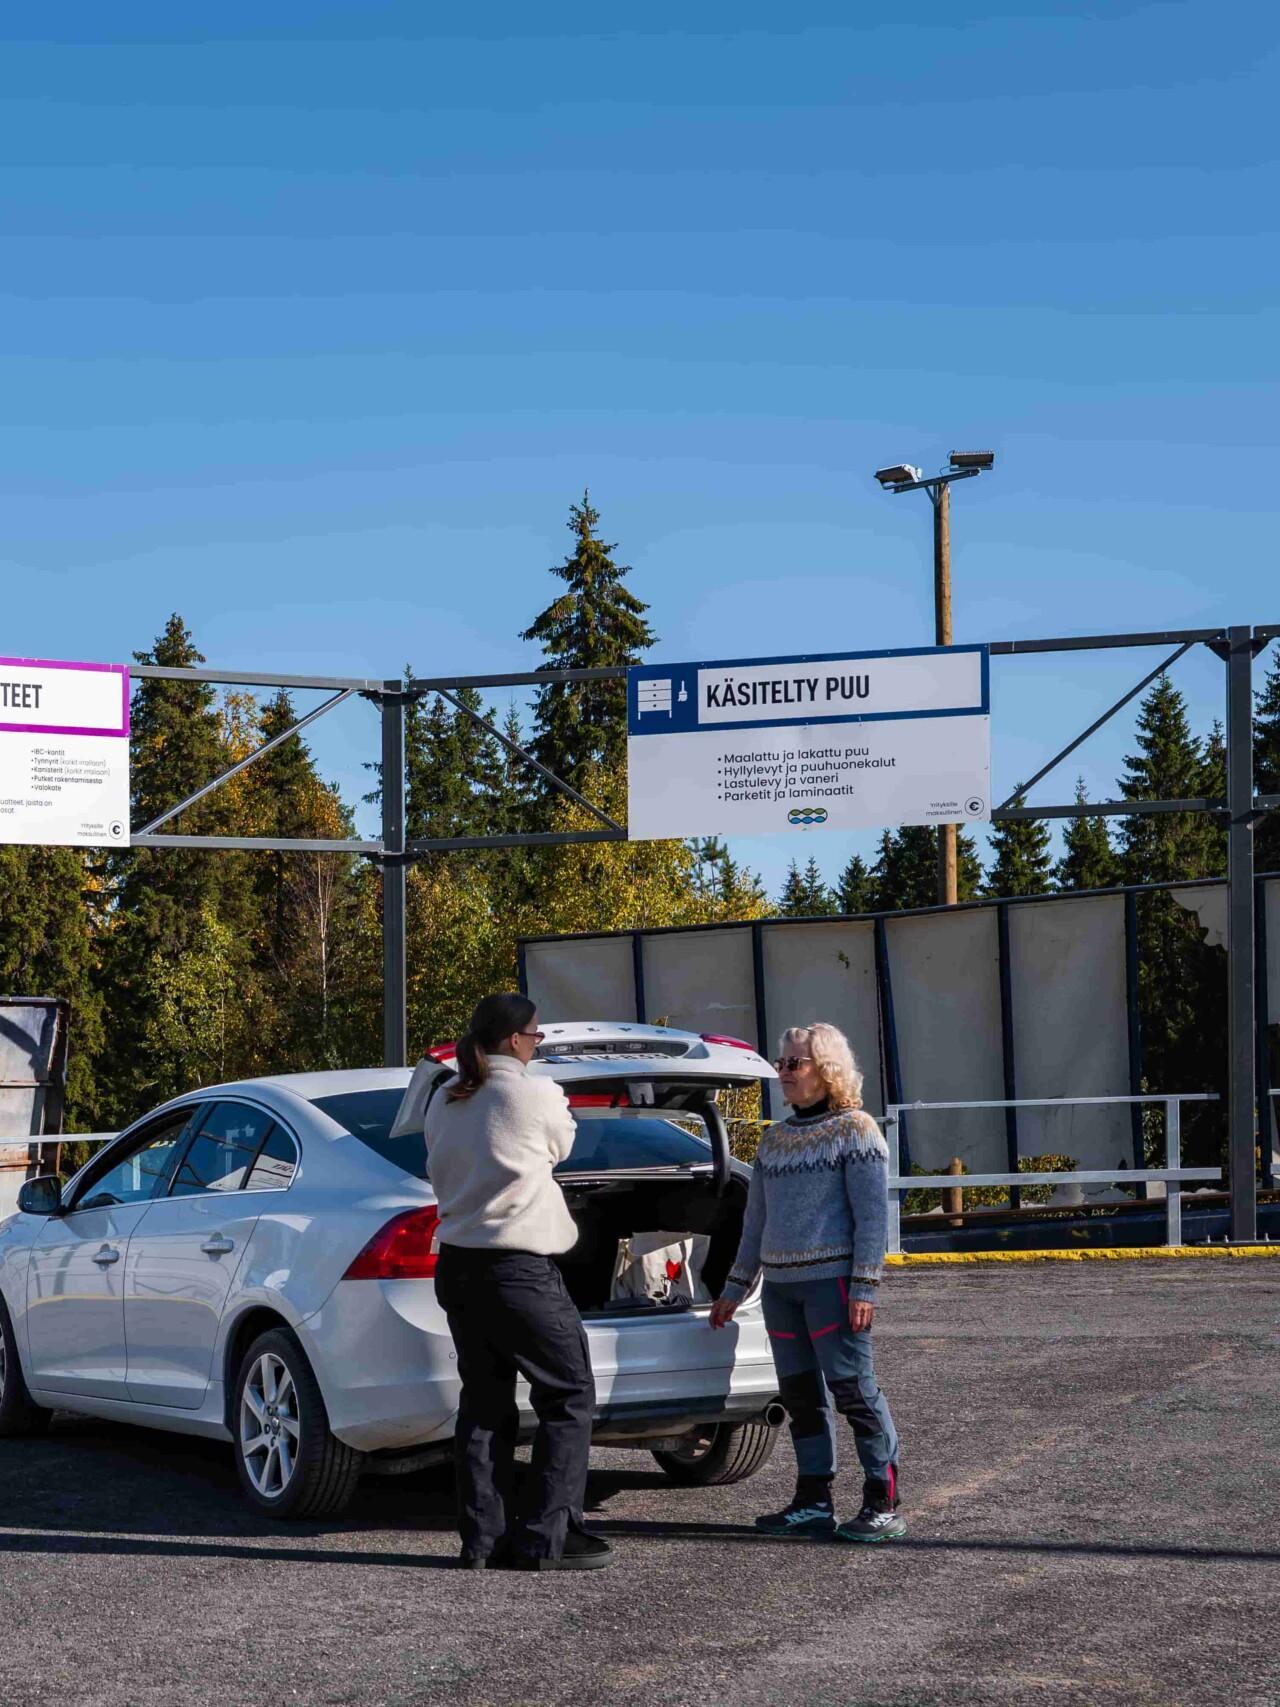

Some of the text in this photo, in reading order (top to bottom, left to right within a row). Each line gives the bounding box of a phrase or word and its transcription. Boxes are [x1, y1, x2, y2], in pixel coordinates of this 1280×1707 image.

[706, 674, 870, 708] KÄSITELTY PUU
[724, 748, 869, 763] Maalattu ja lakattu puu
[724, 757, 896, 778] Hyllylevyt ja puuhuonekalut
[724, 773, 839, 789] Lastulevy ja vaneri
[724, 785, 854, 801] Parketit ja laminaatit
